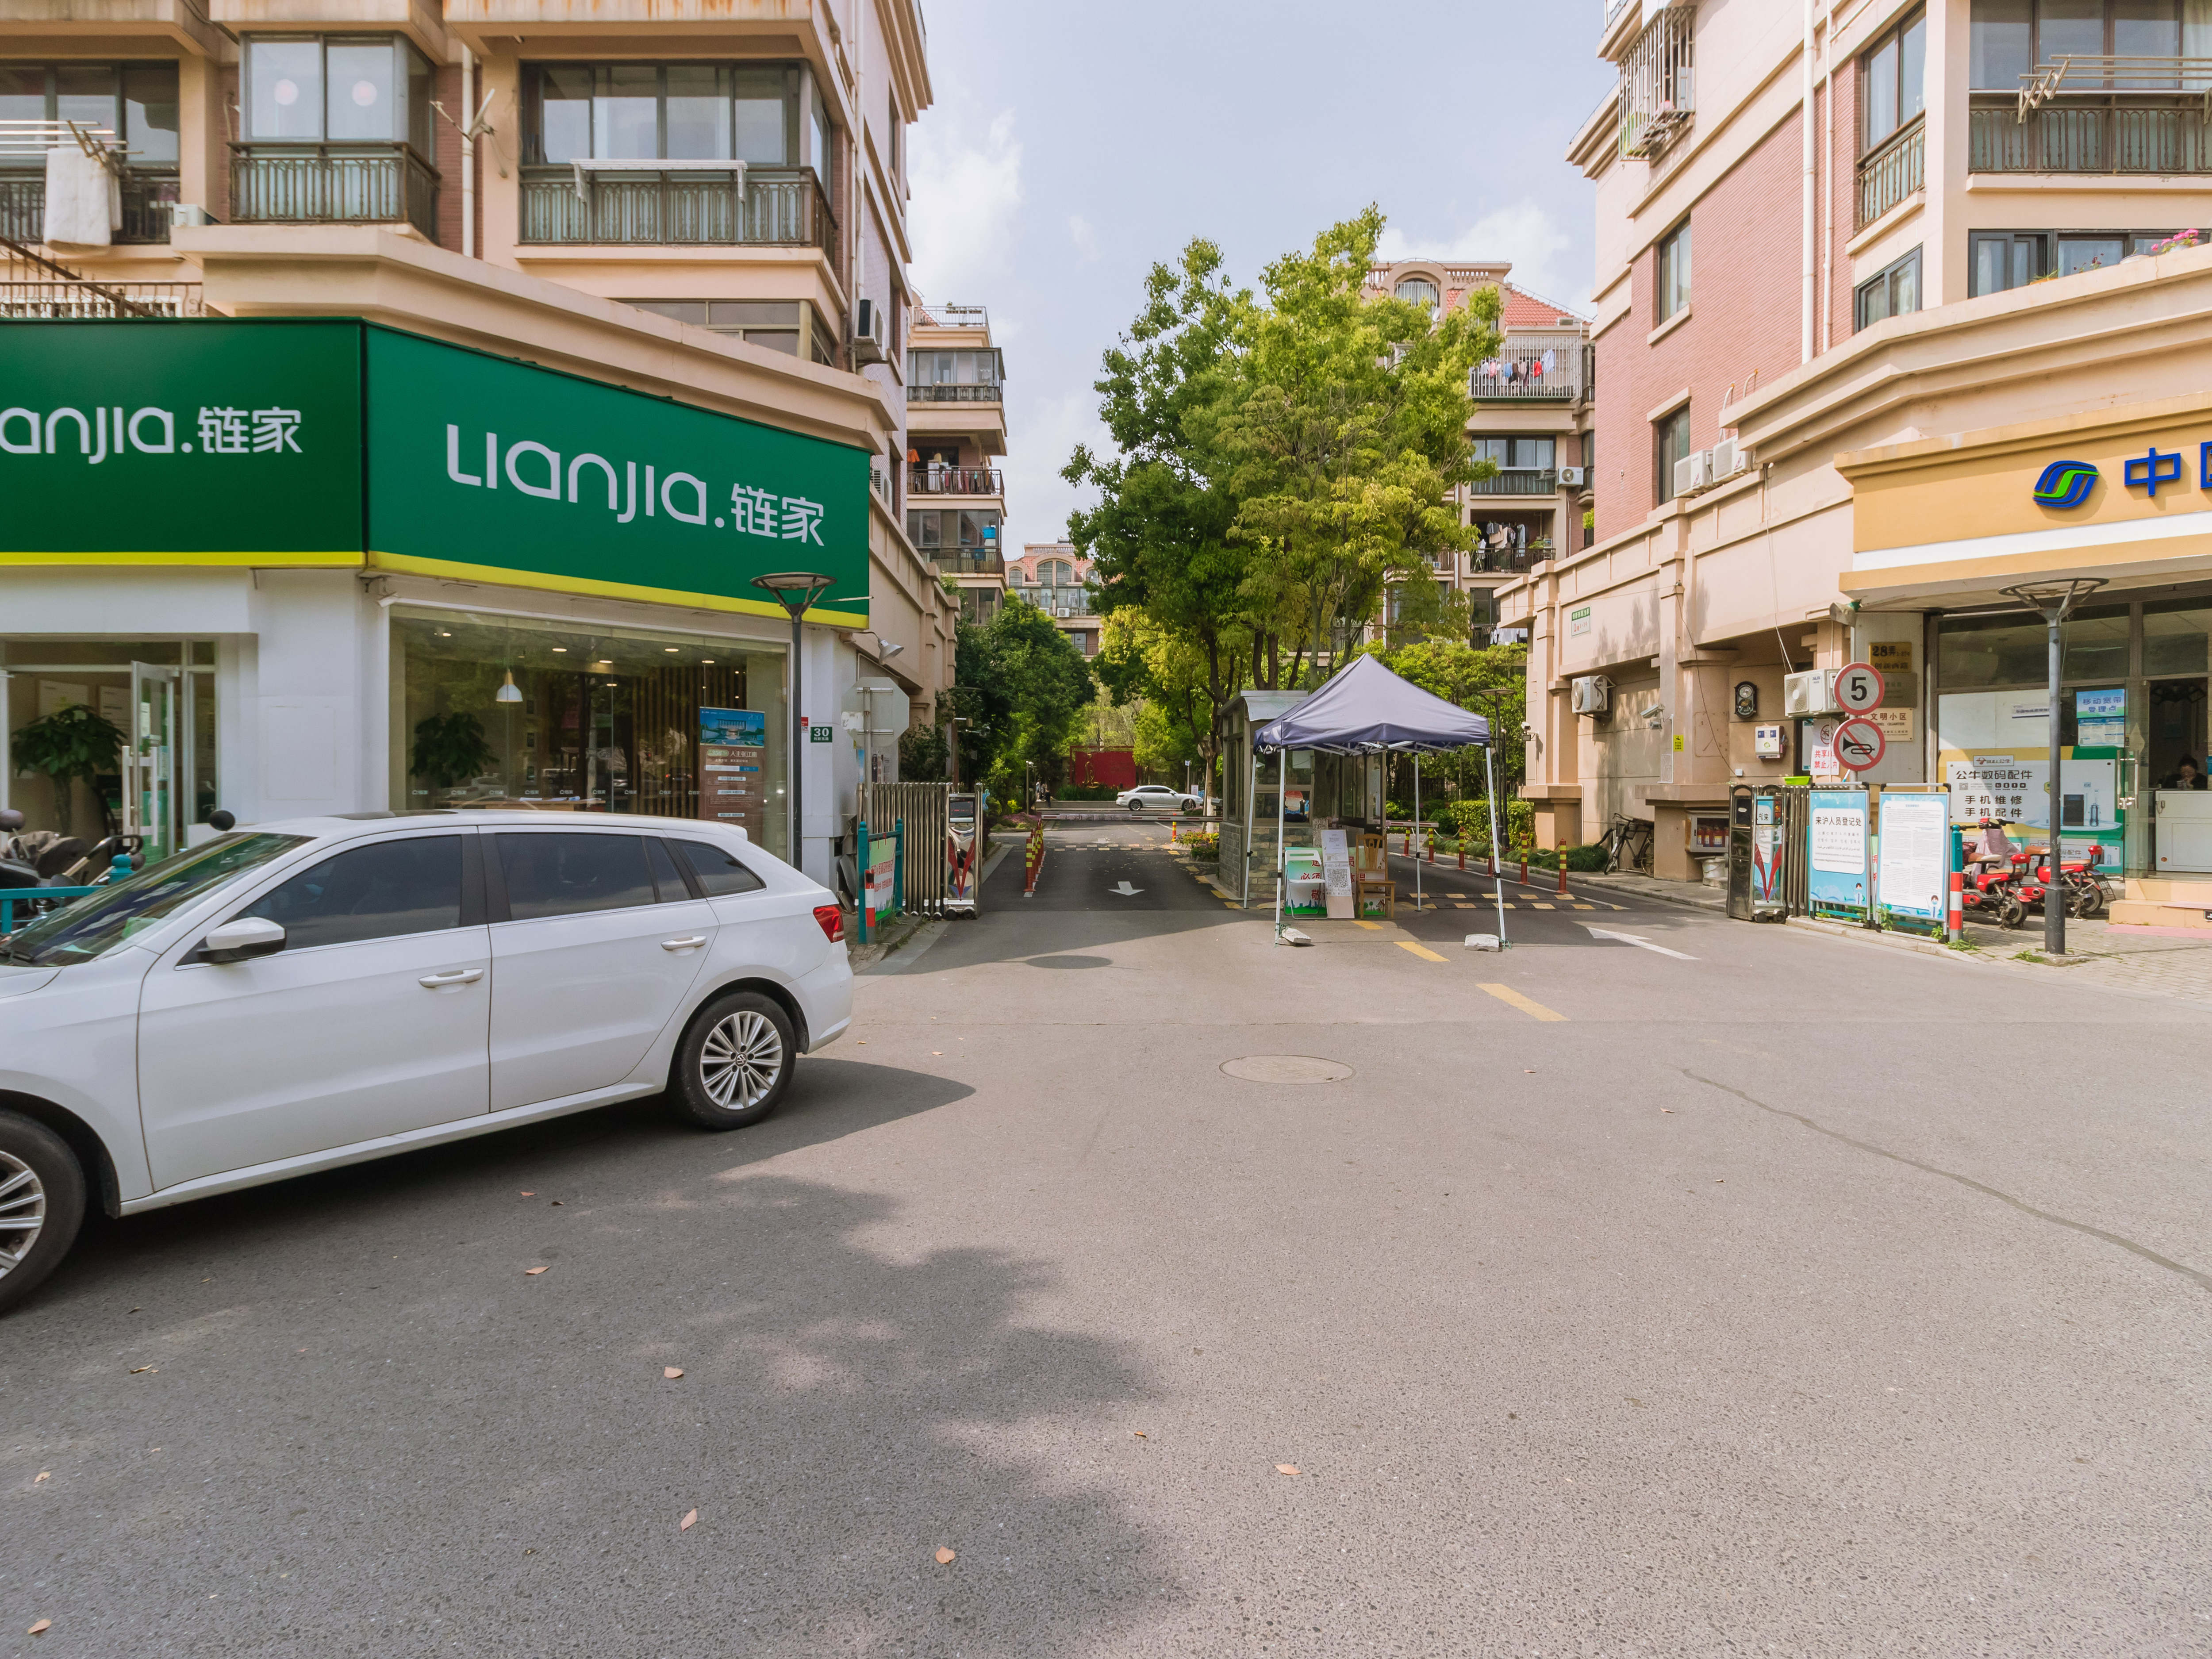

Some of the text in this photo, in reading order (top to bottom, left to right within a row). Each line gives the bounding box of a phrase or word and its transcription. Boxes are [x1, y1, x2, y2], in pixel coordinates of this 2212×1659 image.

[197, 407, 303, 453] 链家
[2124, 441, 2212, 496] 中
[731, 483, 825, 546] 链家
[1851, 677, 1867, 701] 5
[2083, 696, 2122, 705] 移动宽带
[1870, 712, 1906, 721] 文明小区
[814, 728, 829, 737] 30
[1815, 749, 1836, 758] 共享
[1956, 770, 2033, 780] 公牛数码配件
[1965, 795, 2022, 805] 手机维修
[1965, 808, 2022, 818] 手机配件
[1816, 816, 1862, 826] 来沪人员登记处
